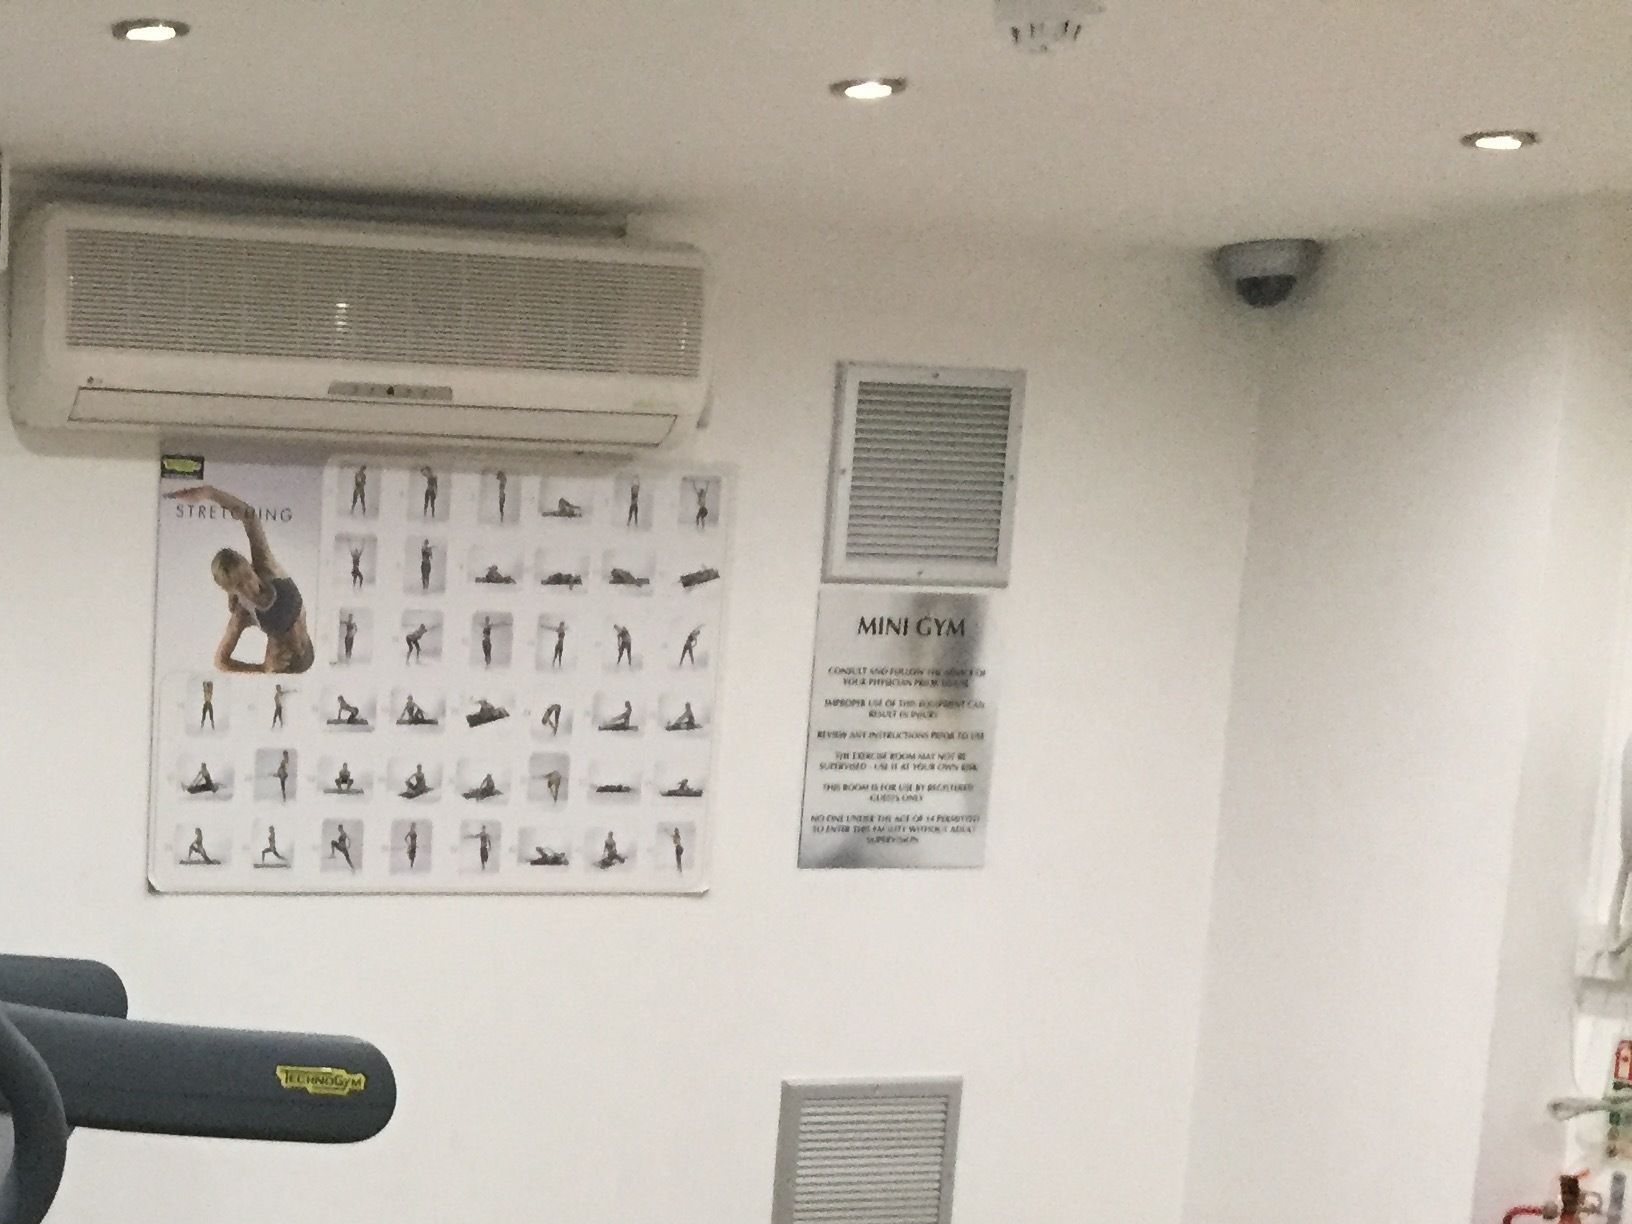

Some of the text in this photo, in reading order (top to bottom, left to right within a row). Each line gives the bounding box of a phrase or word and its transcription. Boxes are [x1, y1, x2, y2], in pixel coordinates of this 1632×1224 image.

[176, 503, 294, 523] STRETCHING
[857, 615, 966, 638] MINI GYM
[280, 1067, 364, 1092] TECHNOGYM
